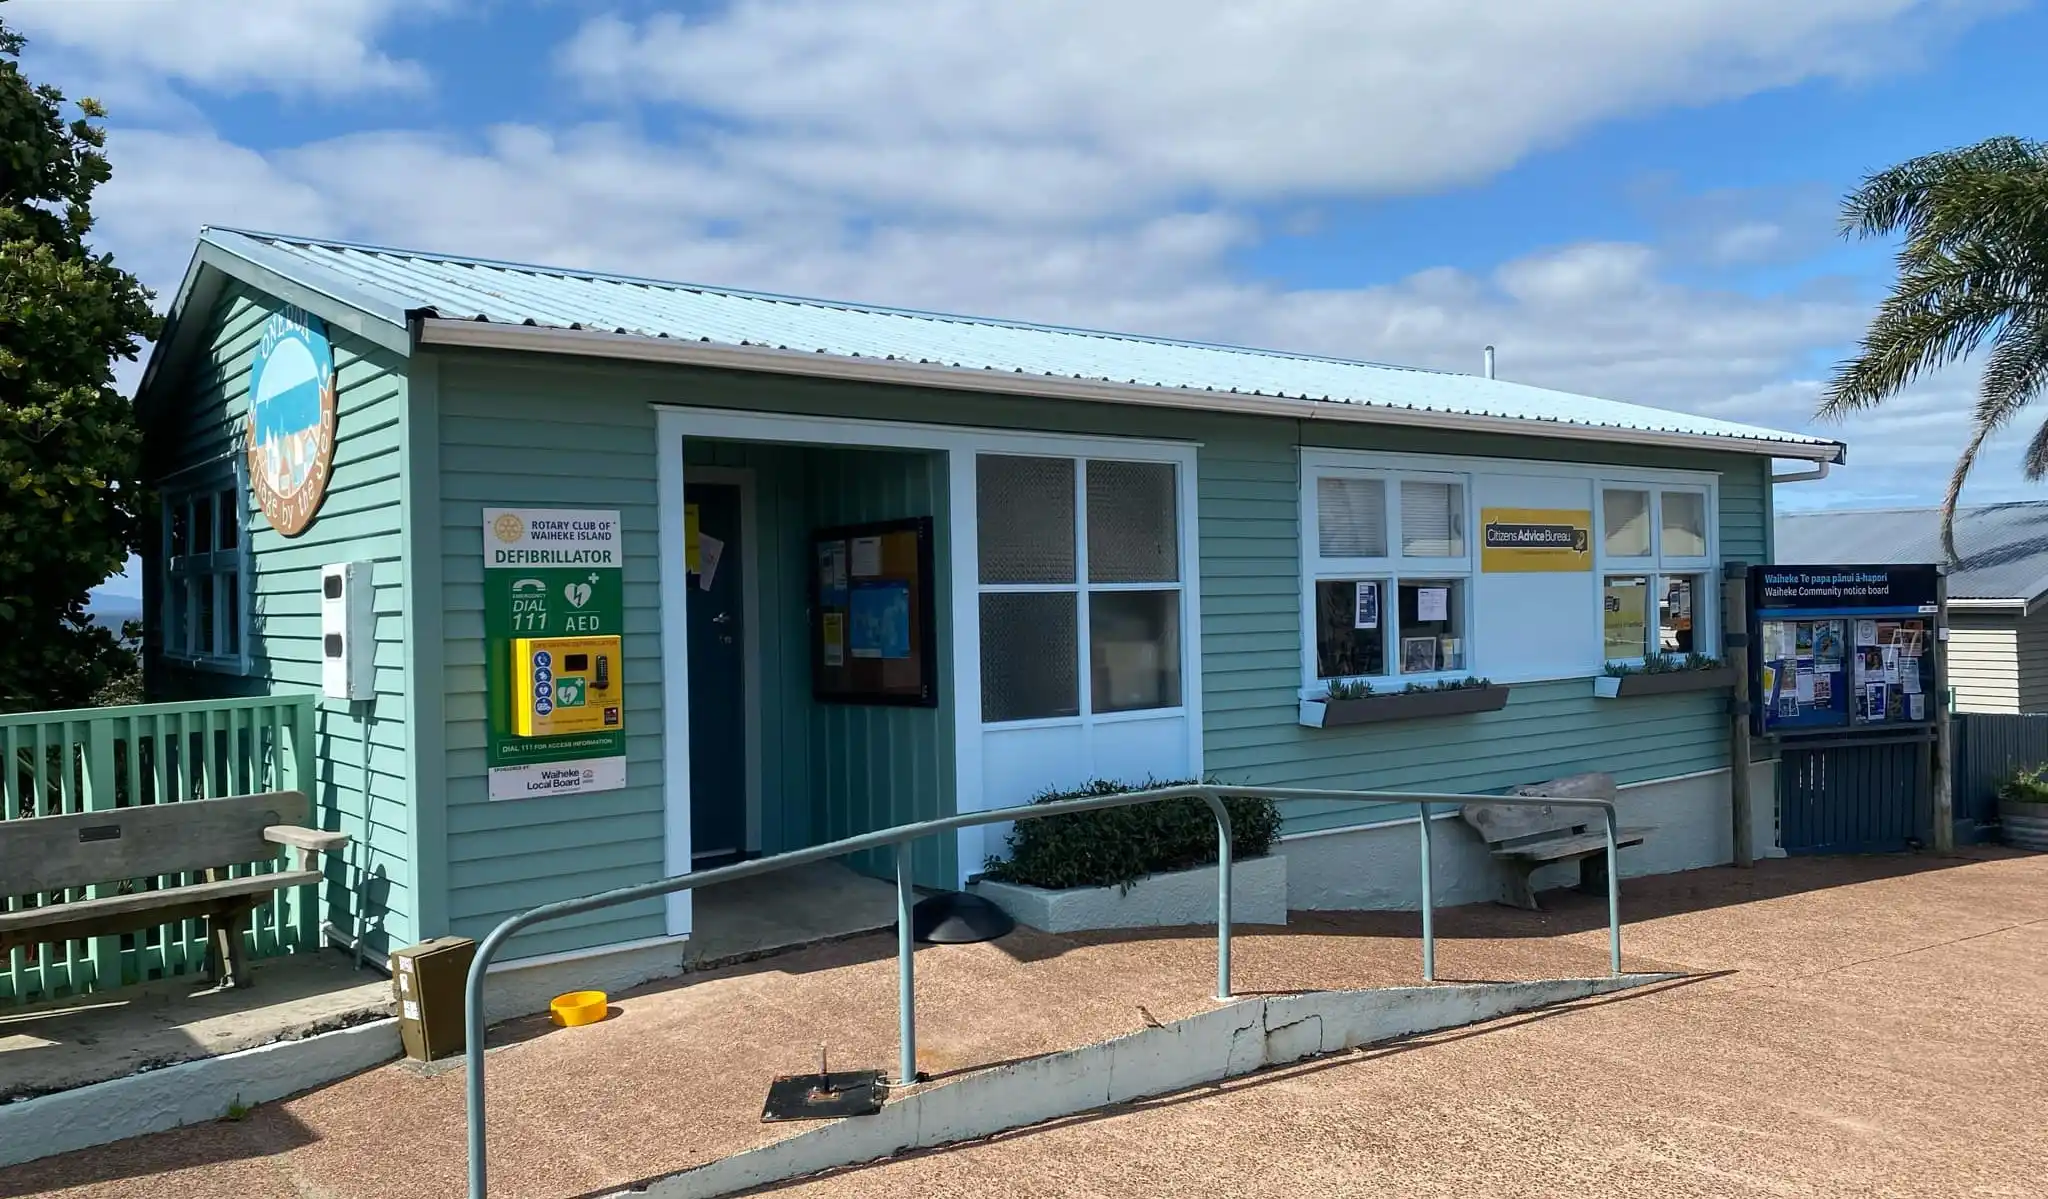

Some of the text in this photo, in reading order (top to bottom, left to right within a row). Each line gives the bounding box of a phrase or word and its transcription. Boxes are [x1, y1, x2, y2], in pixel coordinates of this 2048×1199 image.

[282, 501, 294, 528] by
[298, 479, 315, 516] the
[532, 521, 611, 530] ROTARY CLUB OF
[531, 532, 612, 541] WAIHEKE ISLAND
[1487, 529, 1571, 542] Citizens Advice Bureau
[495, 550, 612, 563] DEFIBRILLATOR
[1765, 574, 1799, 584] Waiheke
[1800, 573, 1810, 583] Te
[1811, 576, 1831, 585] papa
[1765, 585, 1889, 598] Waiheke Community notice board
[513, 600, 546, 612] DIAL
[513, 613, 546, 630] 111
[565, 616, 599, 631] AED
[502, 745, 520, 753] DIAL
[548, 741, 572, 749] ACCESS
[573, 738, 613, 747] INFORMATION
[541, 768, 580, 779] Waiheke
[527, 779, 552, 790] Local
[553, 777, 580, 788] Board
